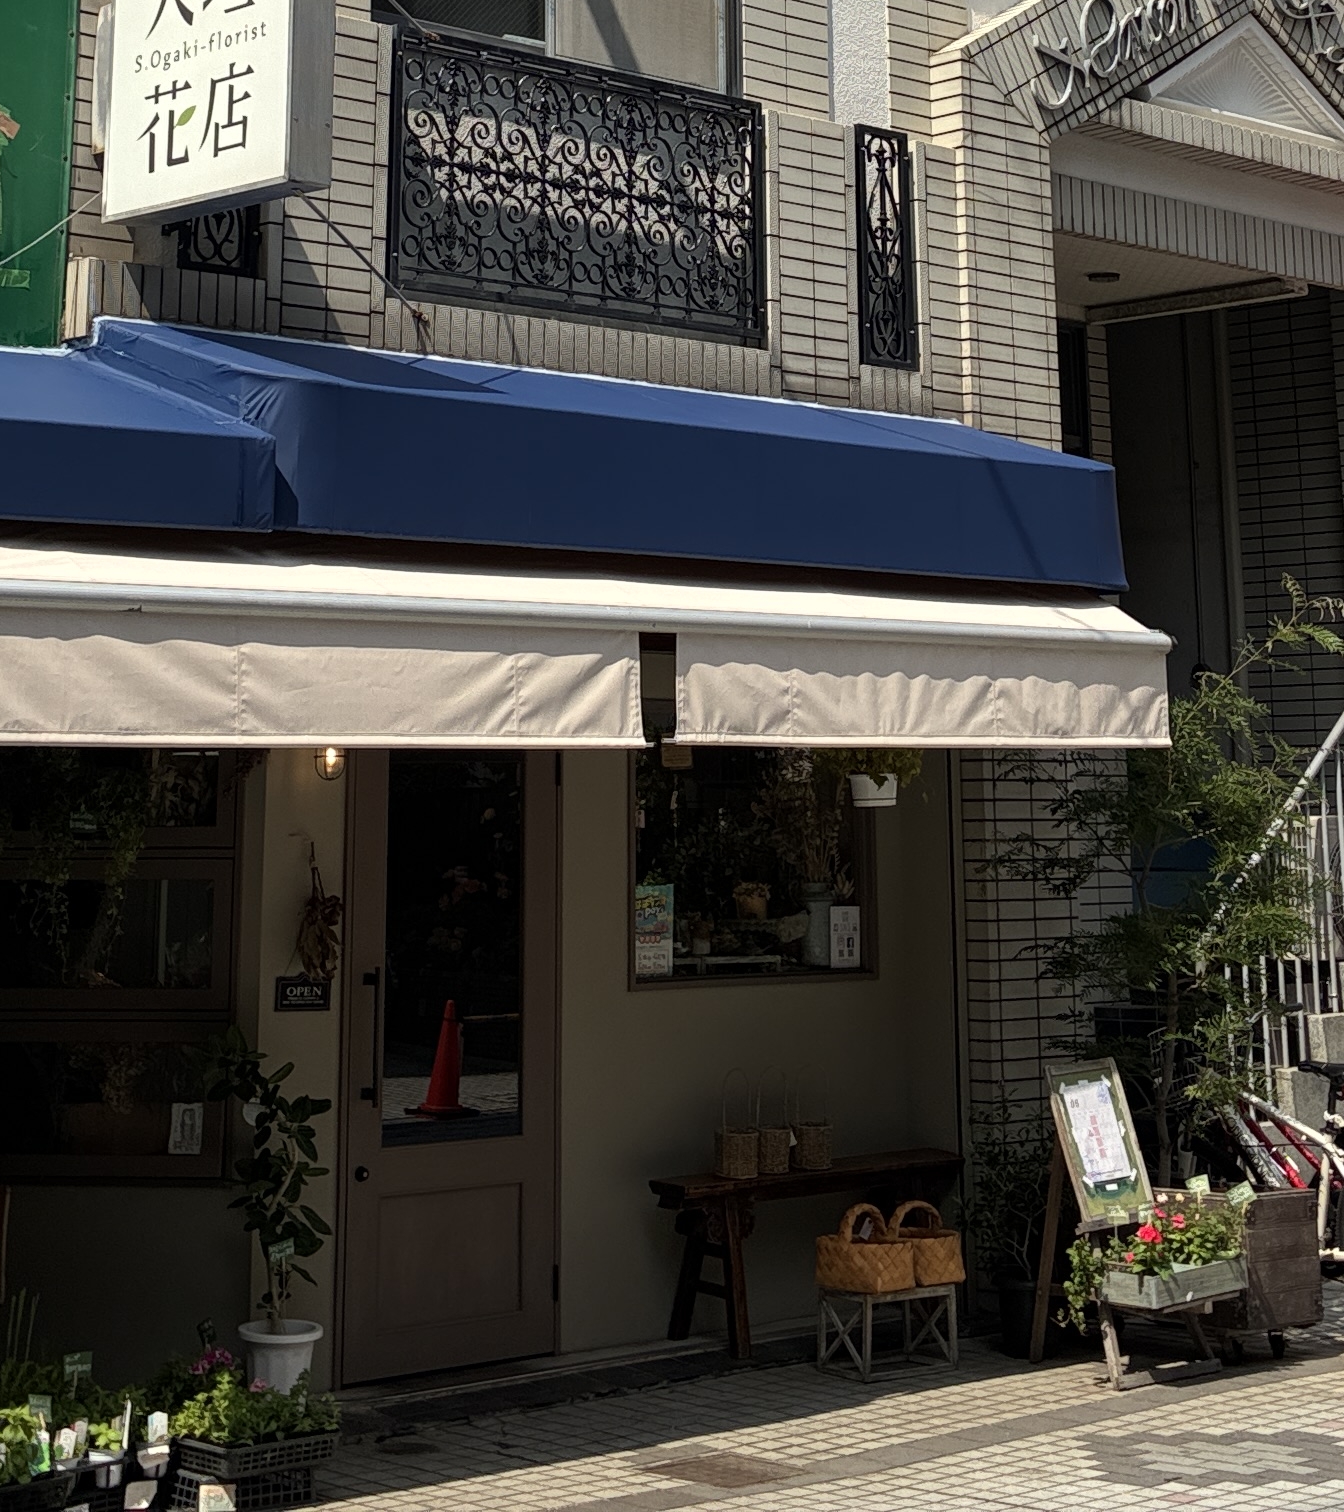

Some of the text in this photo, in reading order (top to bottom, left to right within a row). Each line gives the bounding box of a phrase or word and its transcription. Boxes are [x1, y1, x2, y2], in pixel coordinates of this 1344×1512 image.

[134, 21, 268, 74] S.Ogaki-florist
[136, 62, 256, 174] 花店
[286, 986, 322, 997] OPEN
